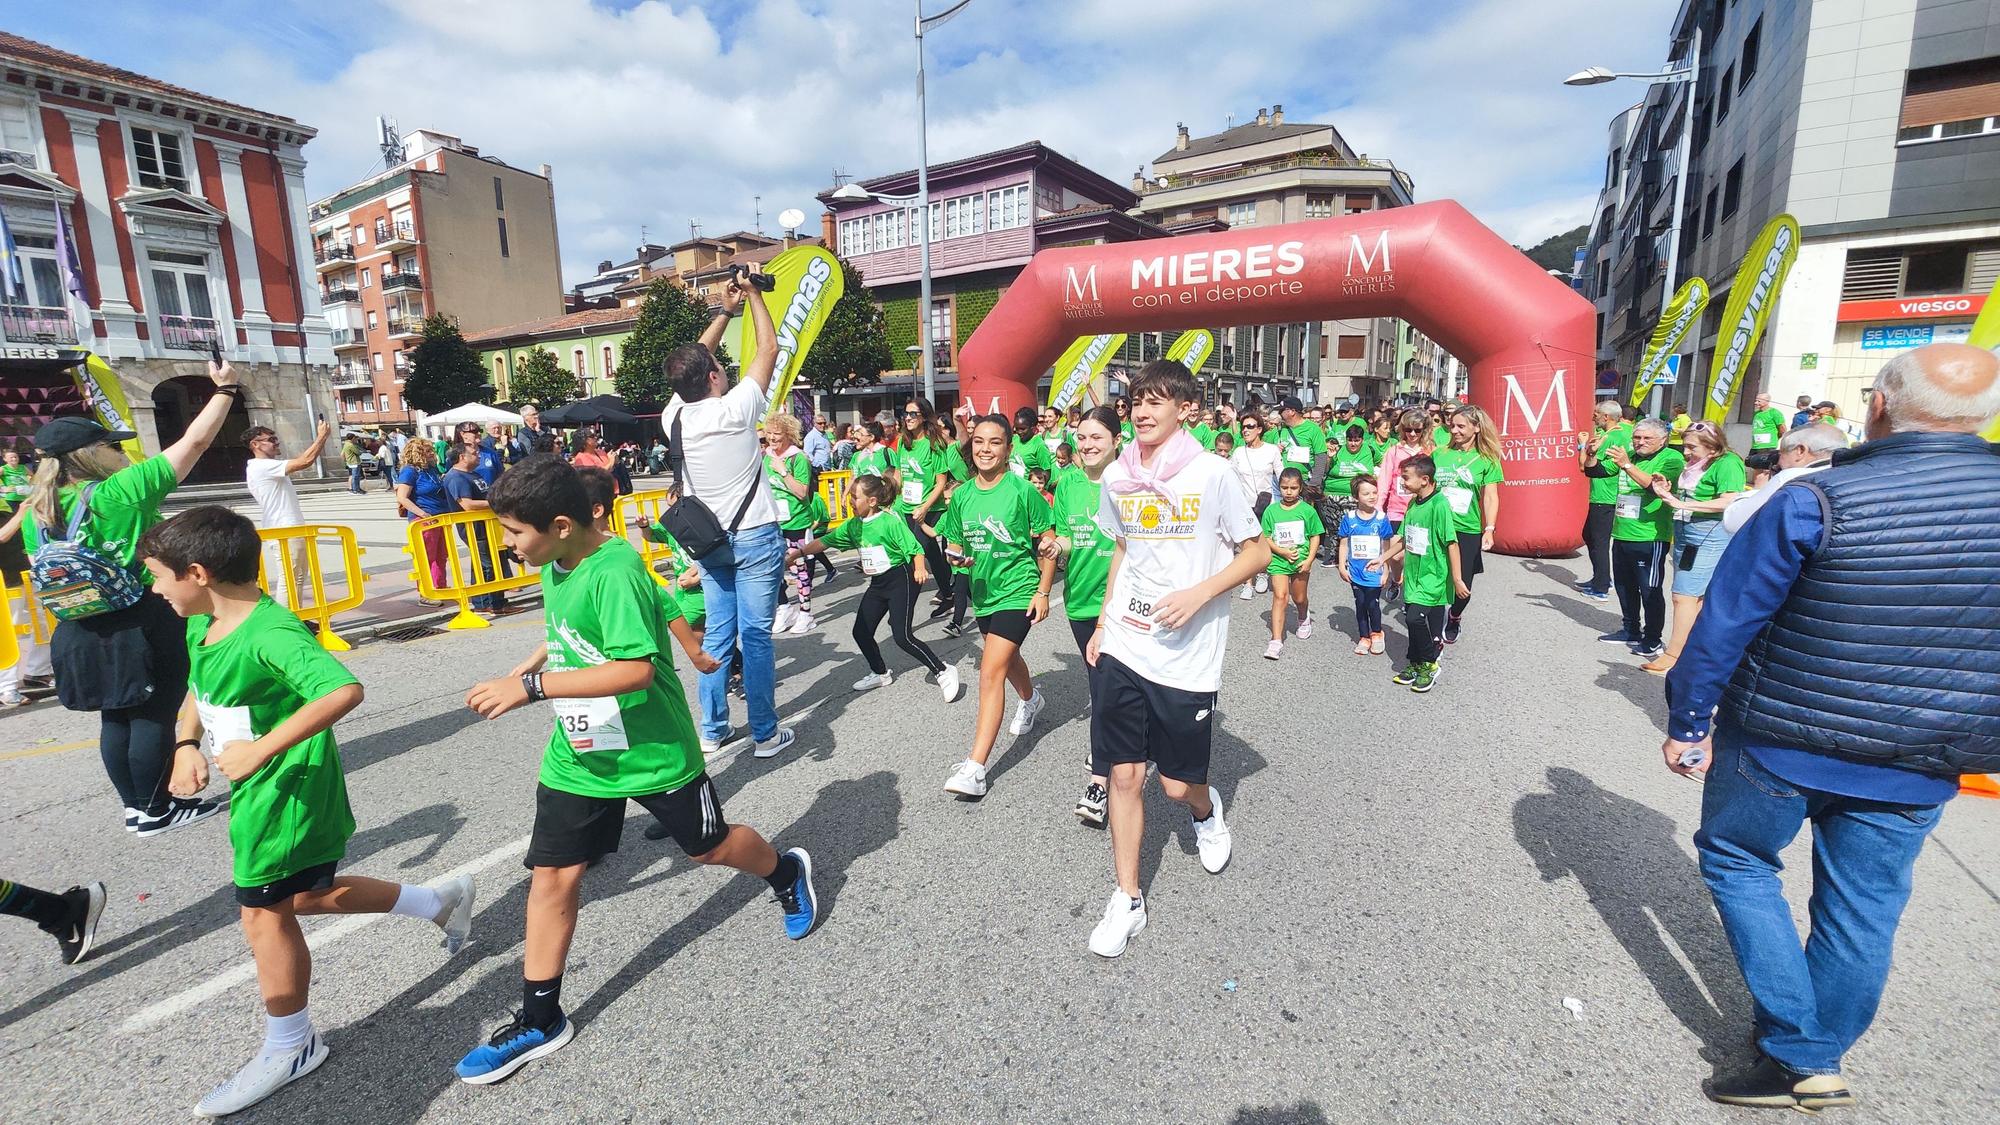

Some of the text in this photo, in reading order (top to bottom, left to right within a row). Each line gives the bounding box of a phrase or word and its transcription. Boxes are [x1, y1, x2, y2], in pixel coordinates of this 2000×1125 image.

[1345, 229, 1393, 277] M
[1131, 241, 1305, 290] MIERES
[1064, 264, 1100, 303] M
[1341, 274, 1382, 287] CONCEYU
[1342, 281, 1396, 296] MIERES
[1132, 279, 1303, 308] con el deporte
[1065, 308, 1105, 320] MIERES
[1711, 224, 1793, 408] masymas
[1866, 327, 1931, 340] SE VENDE
[1500, 369, 1574, 436] M
[1500, 435, 1575, 449] CONCEYU DE
[1500, 444, 1575, 461] MIERES
[1504, 476, 1571, 487] www.mieres.es
[1164, 524, 1195, 534] LAKERS
[1129, 598, 1151, 617] 838
